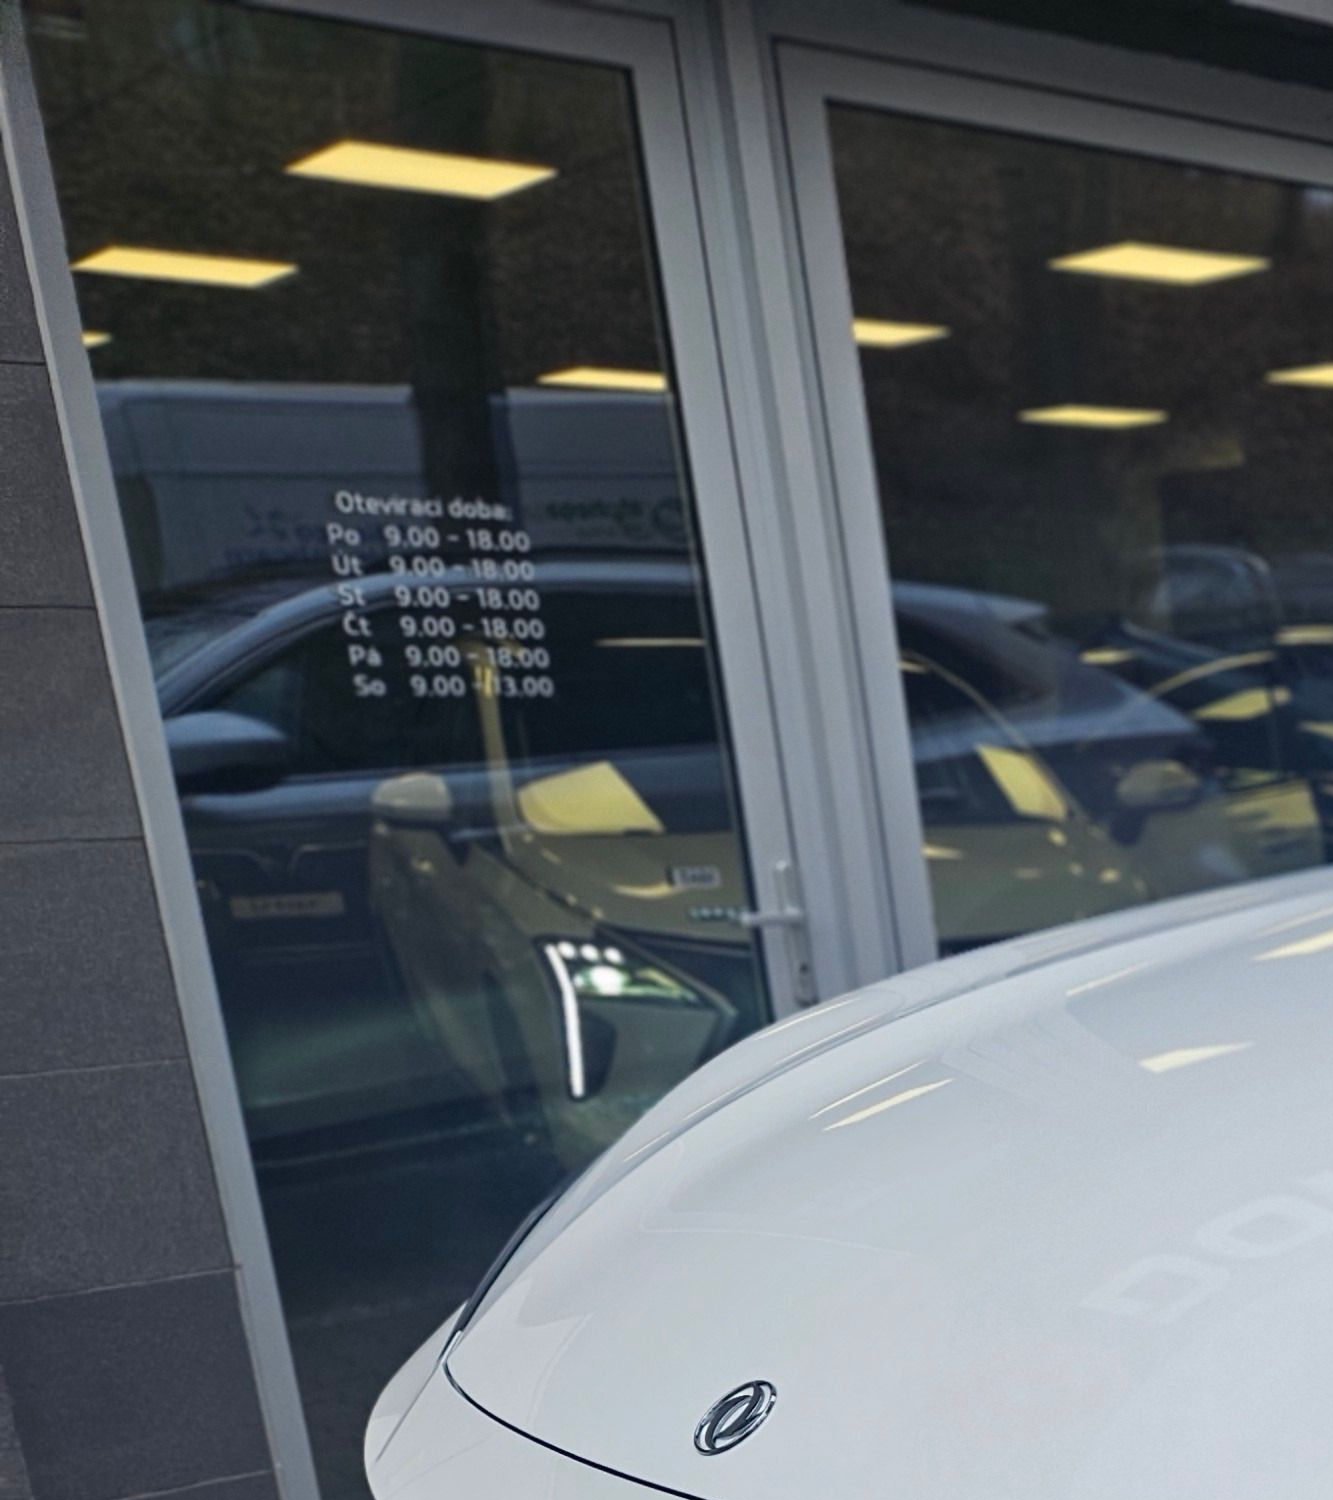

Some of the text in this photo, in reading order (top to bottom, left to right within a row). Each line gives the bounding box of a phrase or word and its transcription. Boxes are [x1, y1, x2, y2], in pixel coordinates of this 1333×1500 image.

[326, 522, 360, 546] Po
[384, 525, 440, 548] 9.00
[466, 528, 531, 552] 18.00
[389, 556, 445, 577] 9.00
[472, 558, 535, 580] 18.00
[394, 586, 450, 608] 9.00
[476, 587, 540, 610] 18.00
[400, 615, 455, 637] 9.00
[481, 618, 545, 639] 18.00
[405, 645, 460, 667] 9.00
[487, 647, 550, 668] 18.00
[353, 674, 386, 697] So
[410, 674, 465, 697] 9.00
[493, 676, 554, 698] 13.00
